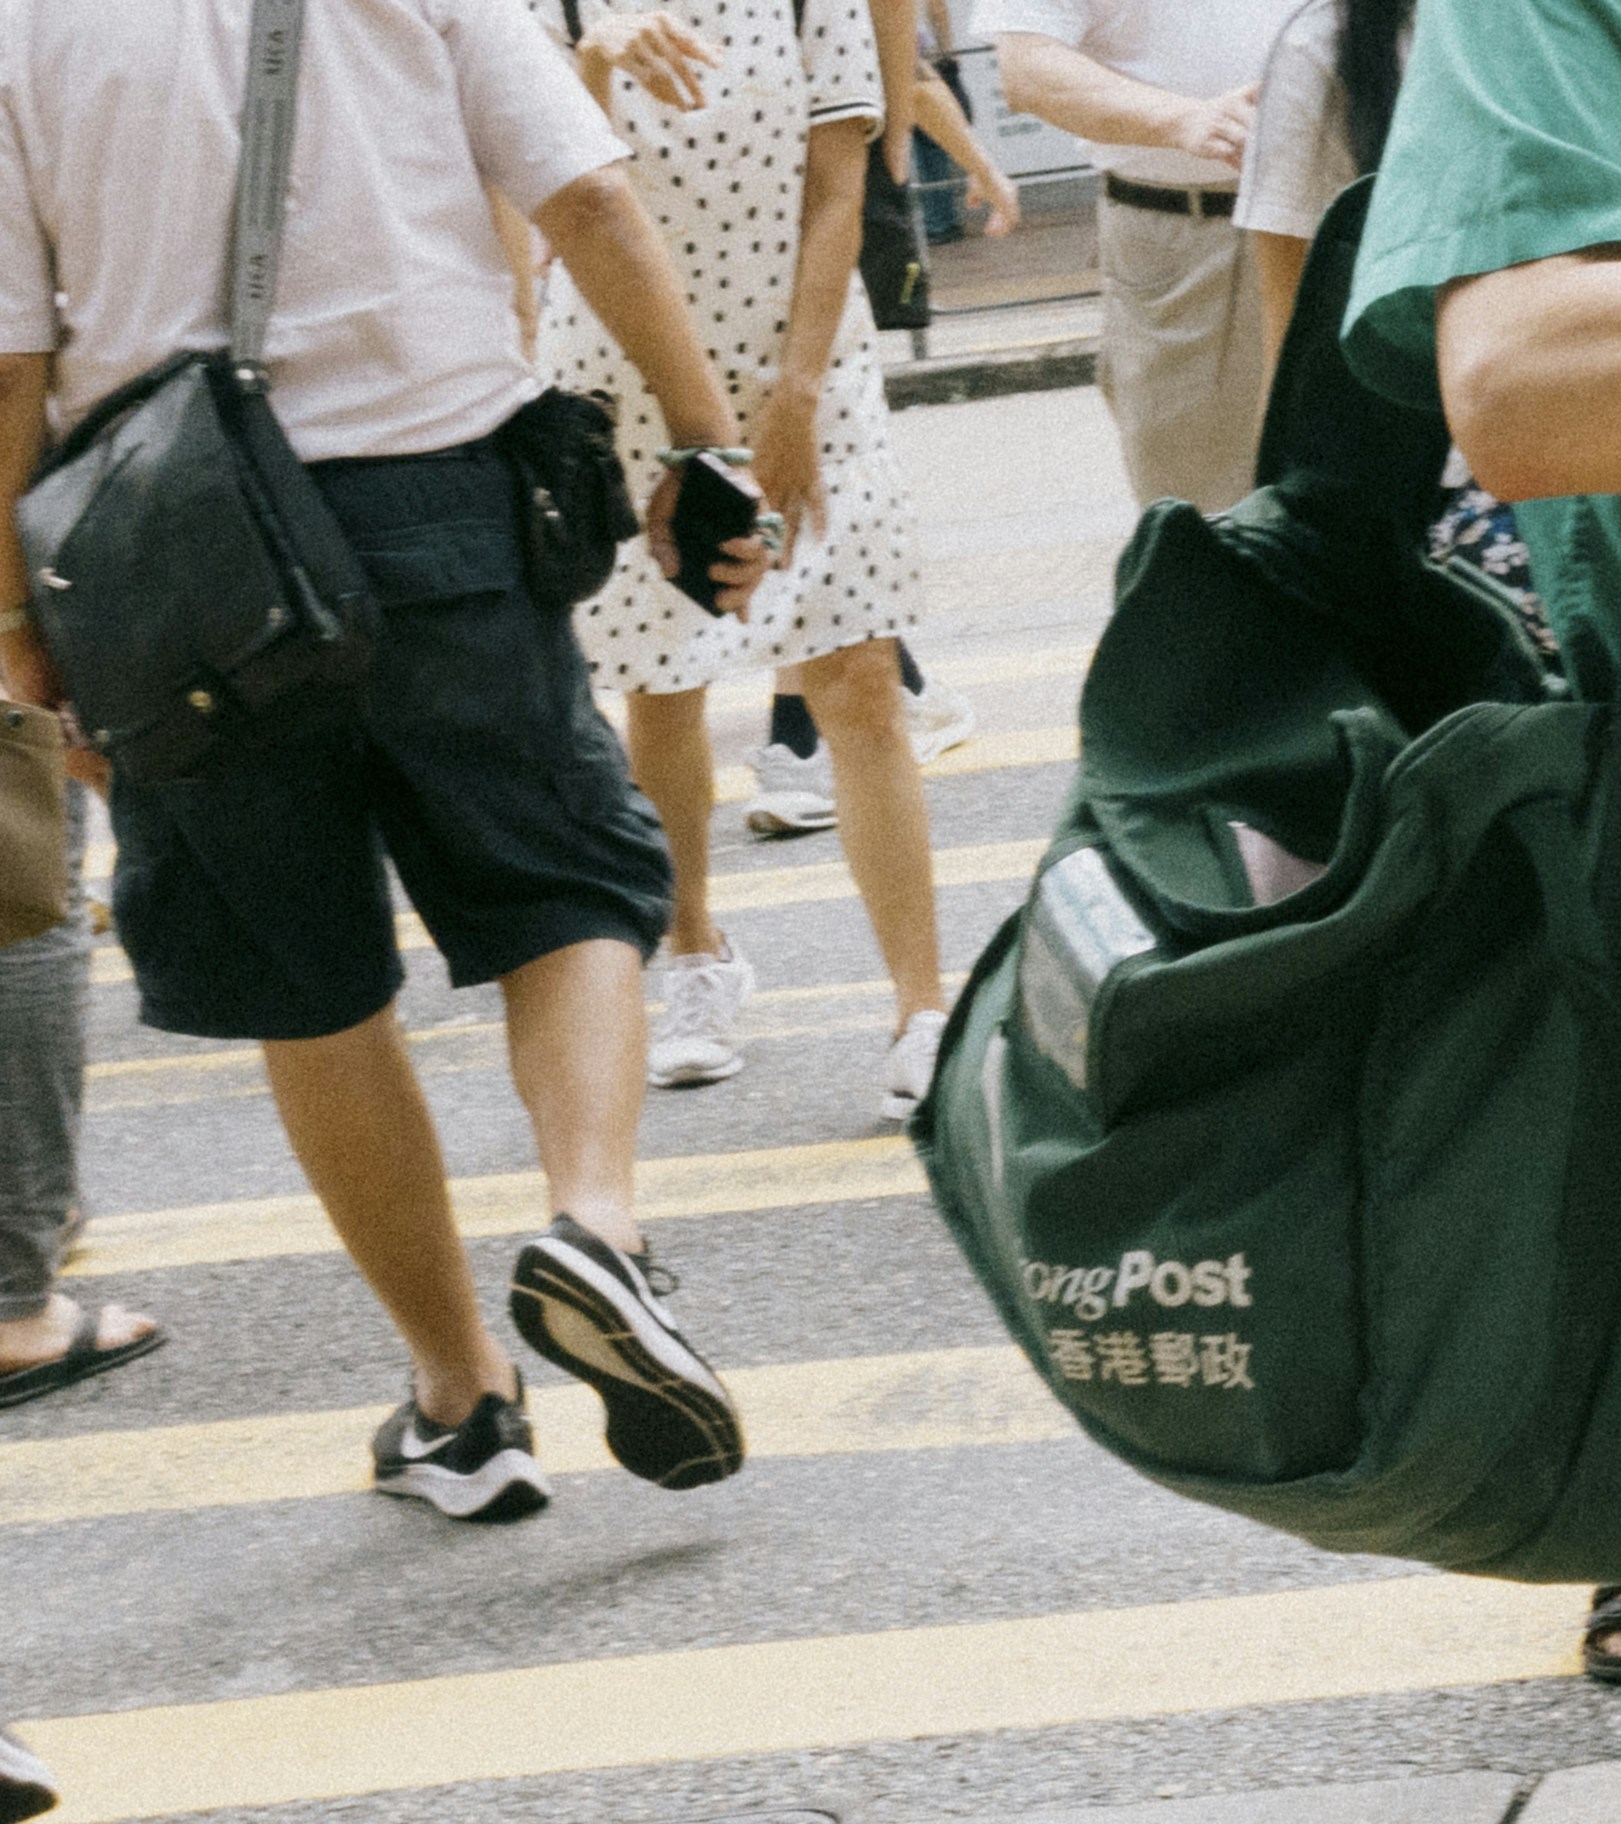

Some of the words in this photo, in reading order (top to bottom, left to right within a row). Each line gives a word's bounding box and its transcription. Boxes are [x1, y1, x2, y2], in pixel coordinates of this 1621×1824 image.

[1018, 1250, 1253, 1321] ongPost
[1049, 1329, 1255, 1390] 香港郵政
